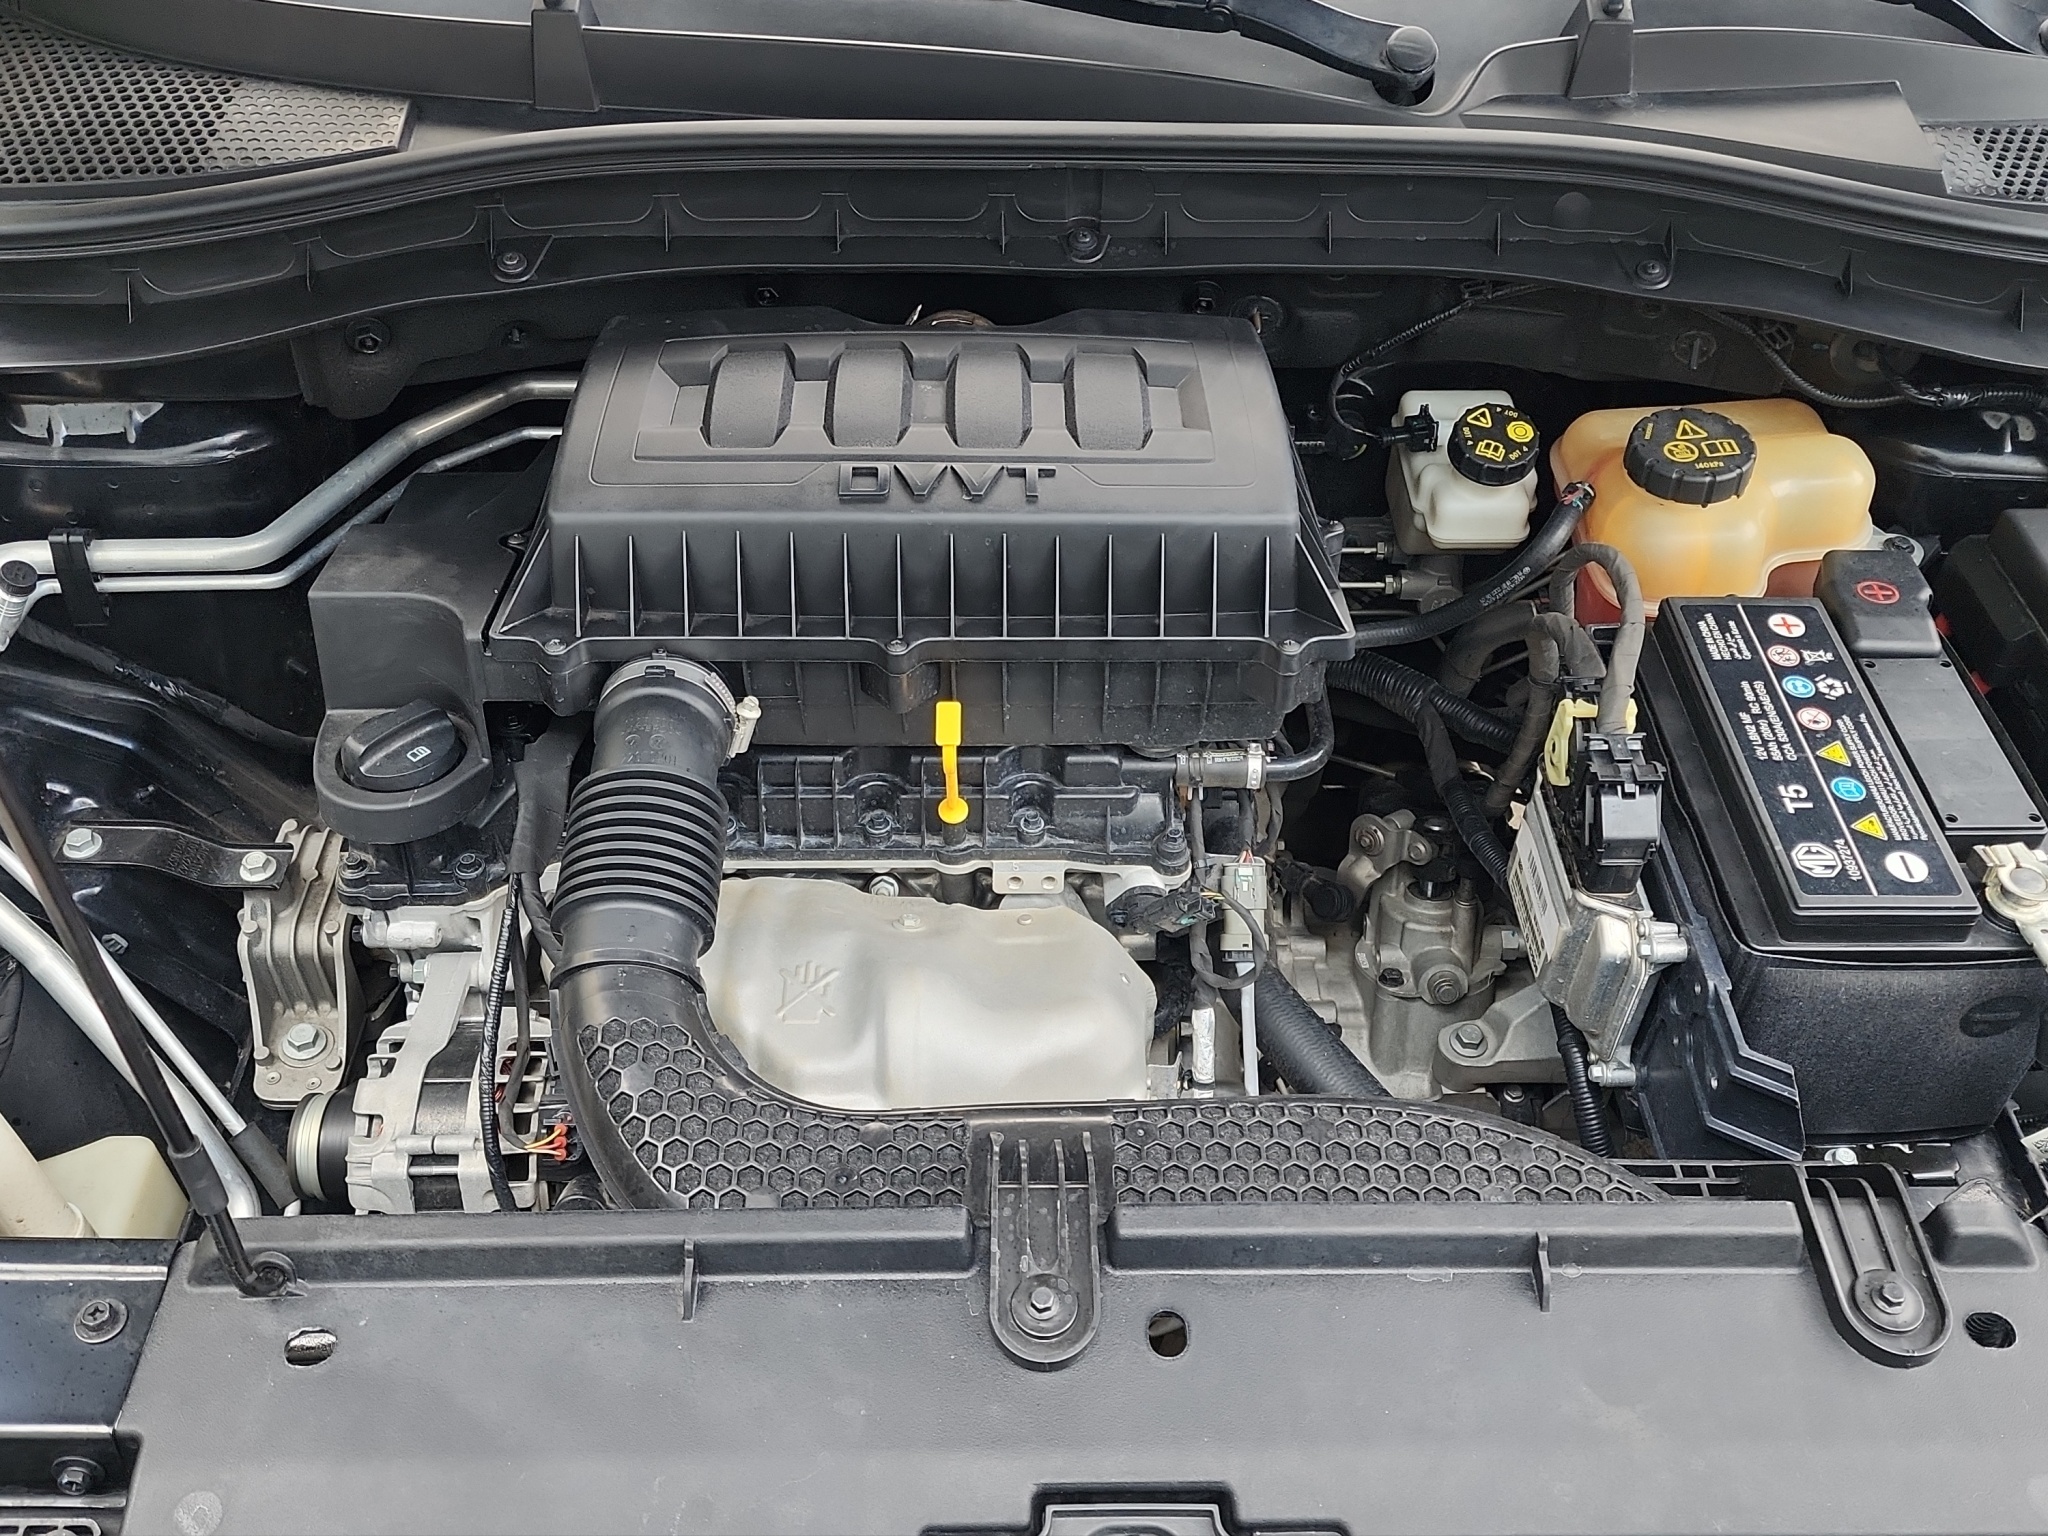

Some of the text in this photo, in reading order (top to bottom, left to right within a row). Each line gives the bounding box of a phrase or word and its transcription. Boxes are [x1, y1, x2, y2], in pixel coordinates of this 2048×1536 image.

[1504, 409, 1519, 418] DOT
[1462, 426, 1473, 438] DOT
[1508, 449, 1522, 461] DOT
[838, 464, 1057, 500] DVVT
[1698, 621, 1711, 637] CHINA
[1705, 613, 1731, 660] HECHO EN CHINA
[1708, 644, 1721, 660] MADE
[1741, 681, 1783, 760] 55Ah (20hr) RC 90min
[1745, 725, 1762, 744] LBN2
[1844, 733, 1857, 750] SUPPLY
[1850, 730, 1864, 749] SUPPLY
[1754, 746, 1768, 760] 12V
[1782, 743, 1797, 761] CCA
[1852, 751, 1865, 768] POWER
[1860, 750, 1874, 769] POWER
[1778, 784, 1813, 813] T5
[1795, 846, 1839, 874] MG
[1835, 839, 1861, 880] 10937274
